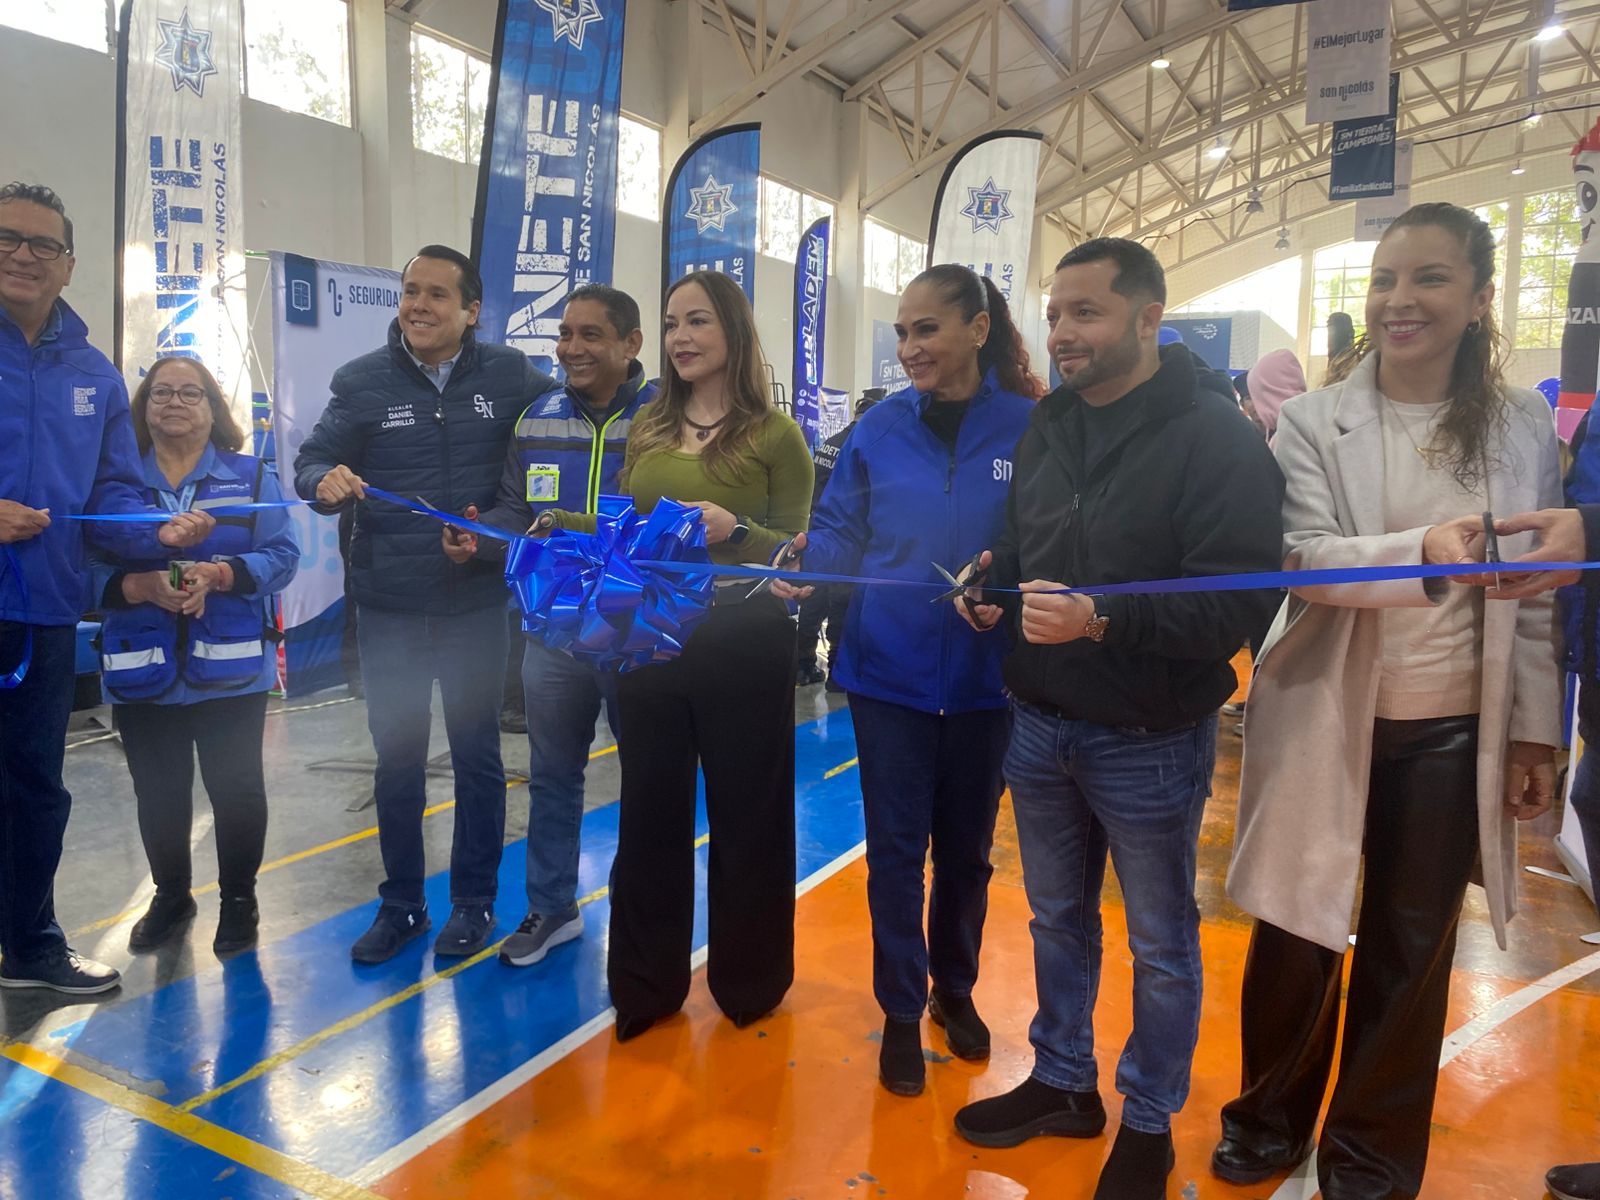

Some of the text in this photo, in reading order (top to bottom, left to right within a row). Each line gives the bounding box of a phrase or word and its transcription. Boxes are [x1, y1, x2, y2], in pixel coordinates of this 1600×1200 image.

[1313, 28, 1385, 50] #ElMejorLugar
[1320, 87, 1337, 98] san
[582, 103, 601, 208] NICOLÁS
[210, 142, 226, 234] NICOLÁS
[577, 214, 592, 262] SAN
[349, 284, 402, 309] SEGURIDA
[382, 418, 415, 428] CARRILLO
[388, 411, 414, 420] DANIEL
